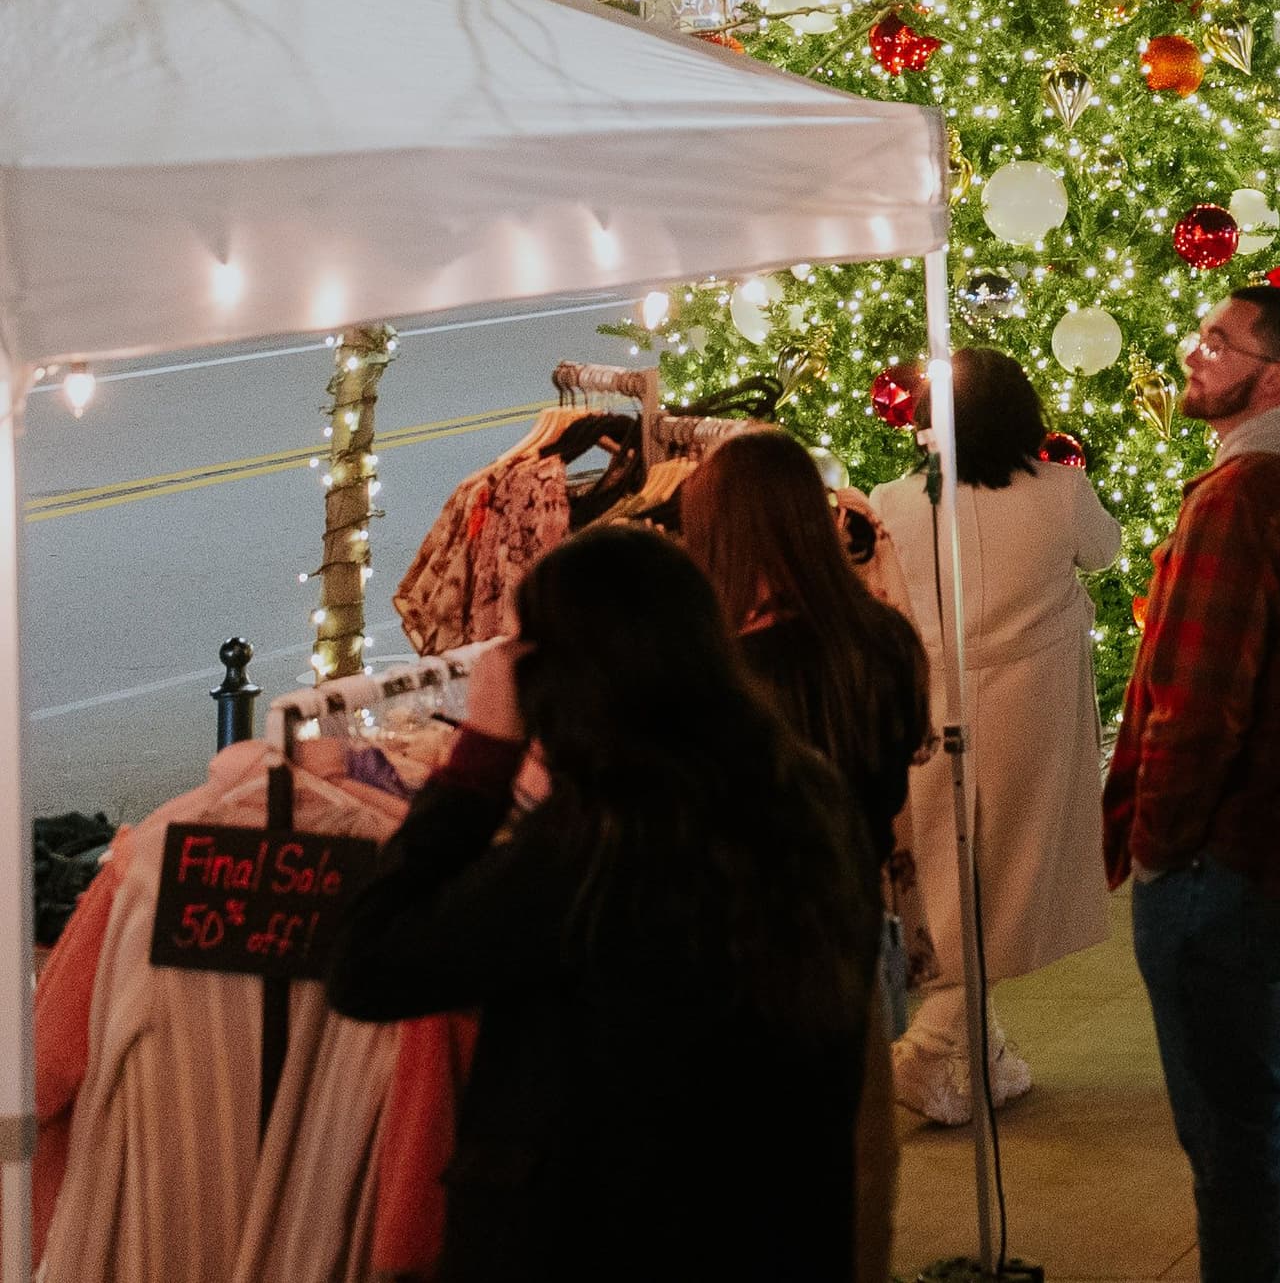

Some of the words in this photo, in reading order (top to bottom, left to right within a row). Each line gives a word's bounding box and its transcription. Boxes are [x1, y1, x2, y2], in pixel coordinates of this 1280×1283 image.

[177, 834, 268, 893] Final
[270, 842, 344, 895] Sale
[174, 898, 248, 950] 50%
